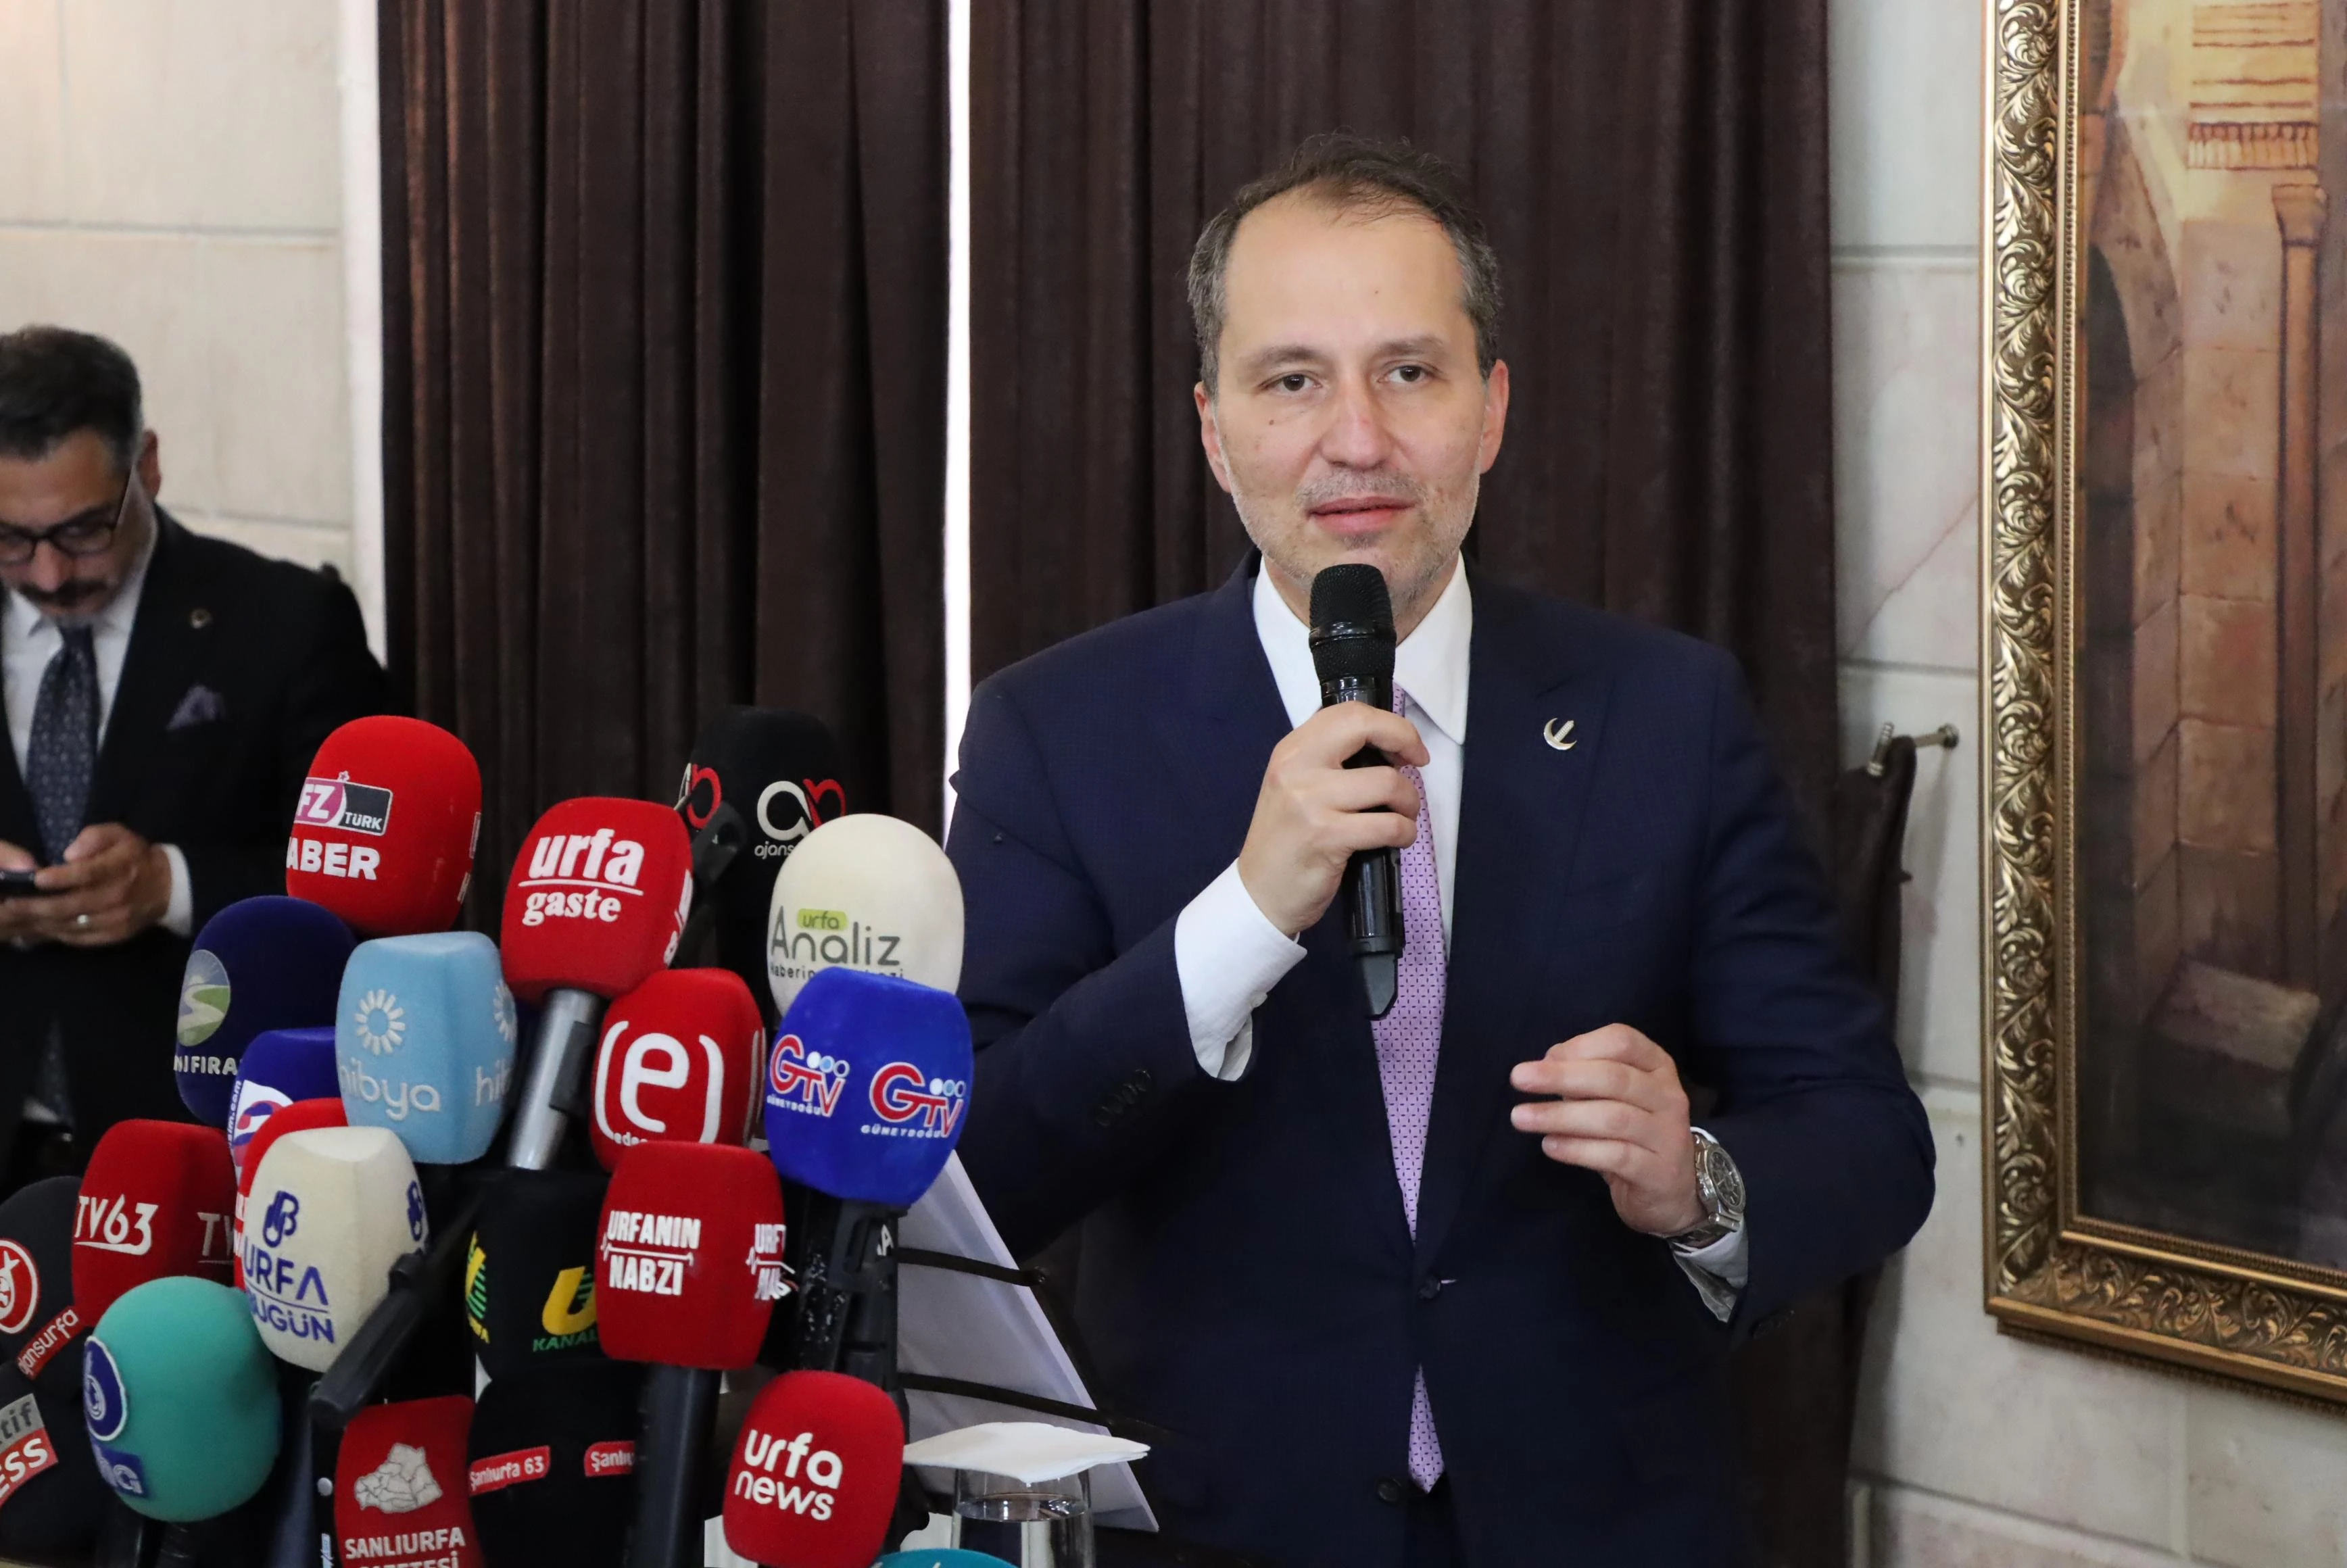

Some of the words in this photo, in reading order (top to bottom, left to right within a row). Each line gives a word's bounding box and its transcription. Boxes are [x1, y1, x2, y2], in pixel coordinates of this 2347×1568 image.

[529, 829, 644, 886] urfa
[522, 889, 621, 926] gaste
[802, 910, 840, 930] urfa
[771, 906, 900, 966] Analiz
[74, 1194, 159, 1255] TV63
[607, 1210, 701, 1250] URFANIN
[609, 1255, 684, 1296] NABZI
[524, 1455, 544, 1475] 63
[744, 1429, 844, 1489] urfa
[734, 1470, 835, 1521] news
